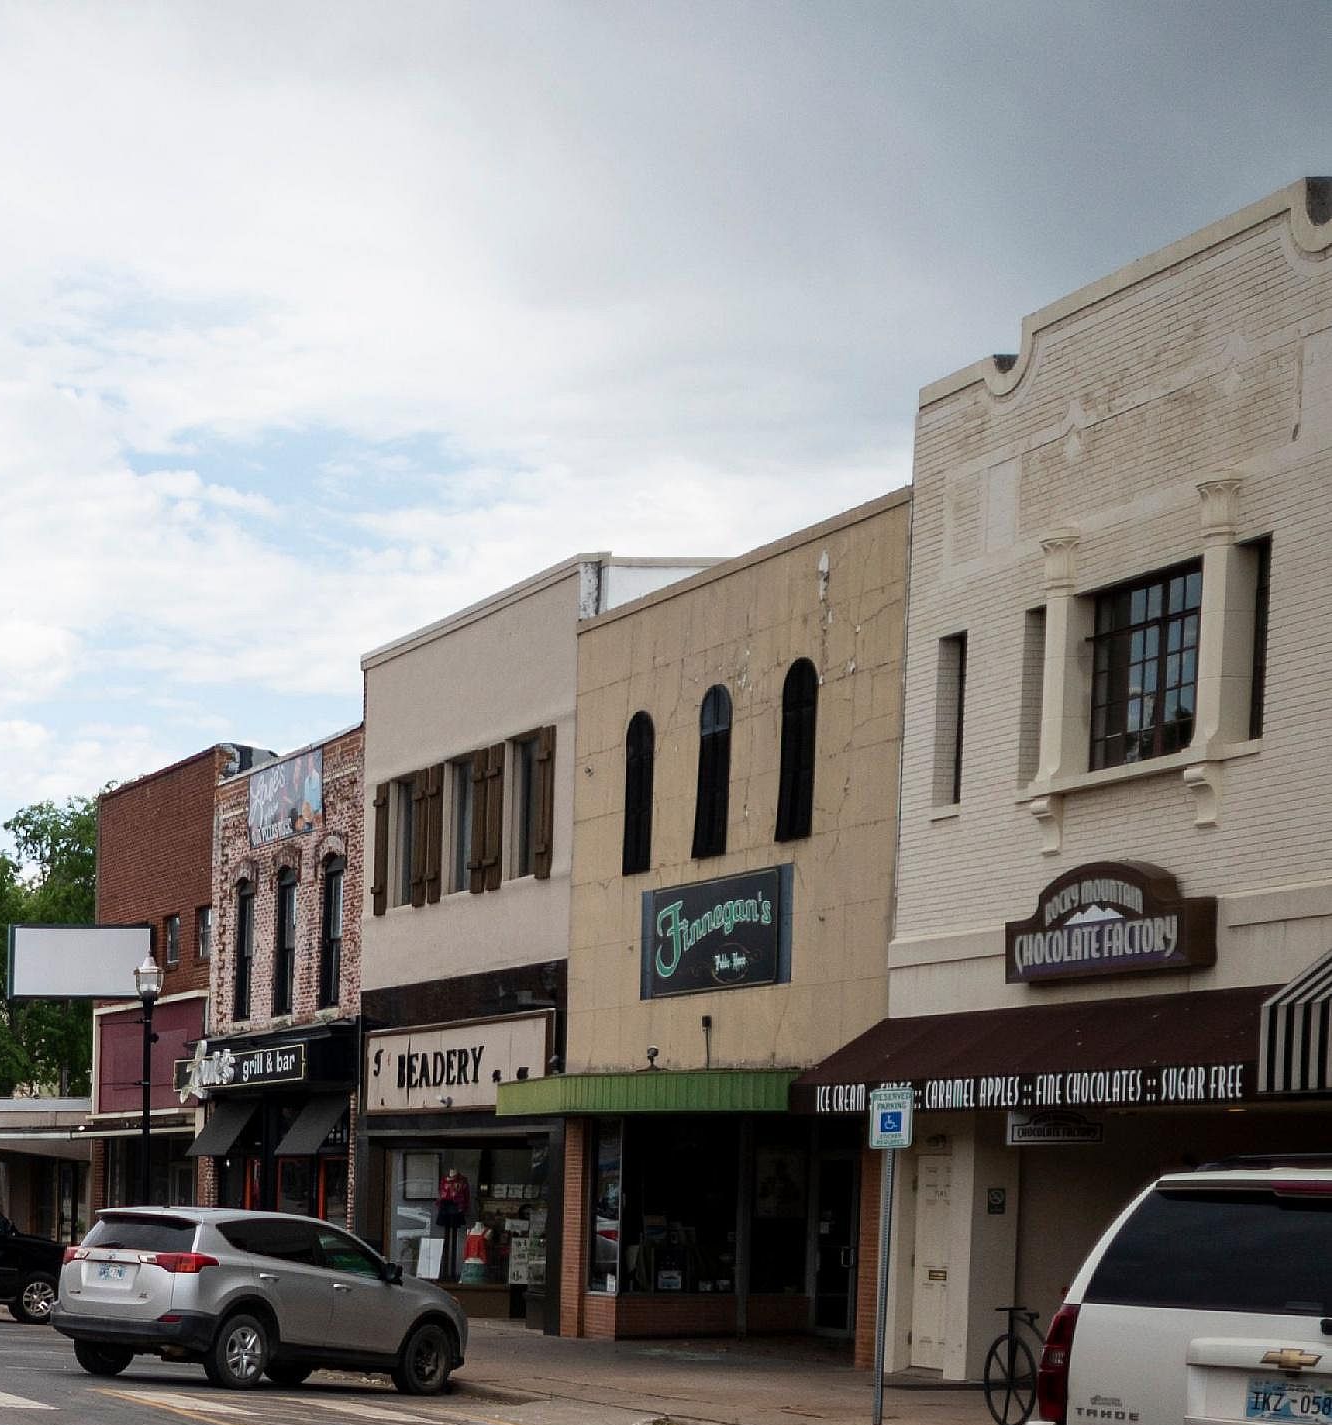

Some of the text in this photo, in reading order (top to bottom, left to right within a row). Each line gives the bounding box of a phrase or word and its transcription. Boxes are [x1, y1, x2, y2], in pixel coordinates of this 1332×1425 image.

[1044, 878, 1144, 927] ROCKY MOUNTAIN
[655, 890, 772, 978] Finnegan's
[1014, 914, 1178, 976] CHOCOLATE FACTORY
[242, 1052, 263, 1082] grill
[266, 1052, 273, 1074] &
[276, 1050, 296, 1073] bar
[817, 1064, 1244, 1112] ICE CREAM CARAMEL APPLES FINE CHOCOLATES SUGAR FREE
[1075, 1407, 1140, 1421] TAHOE
